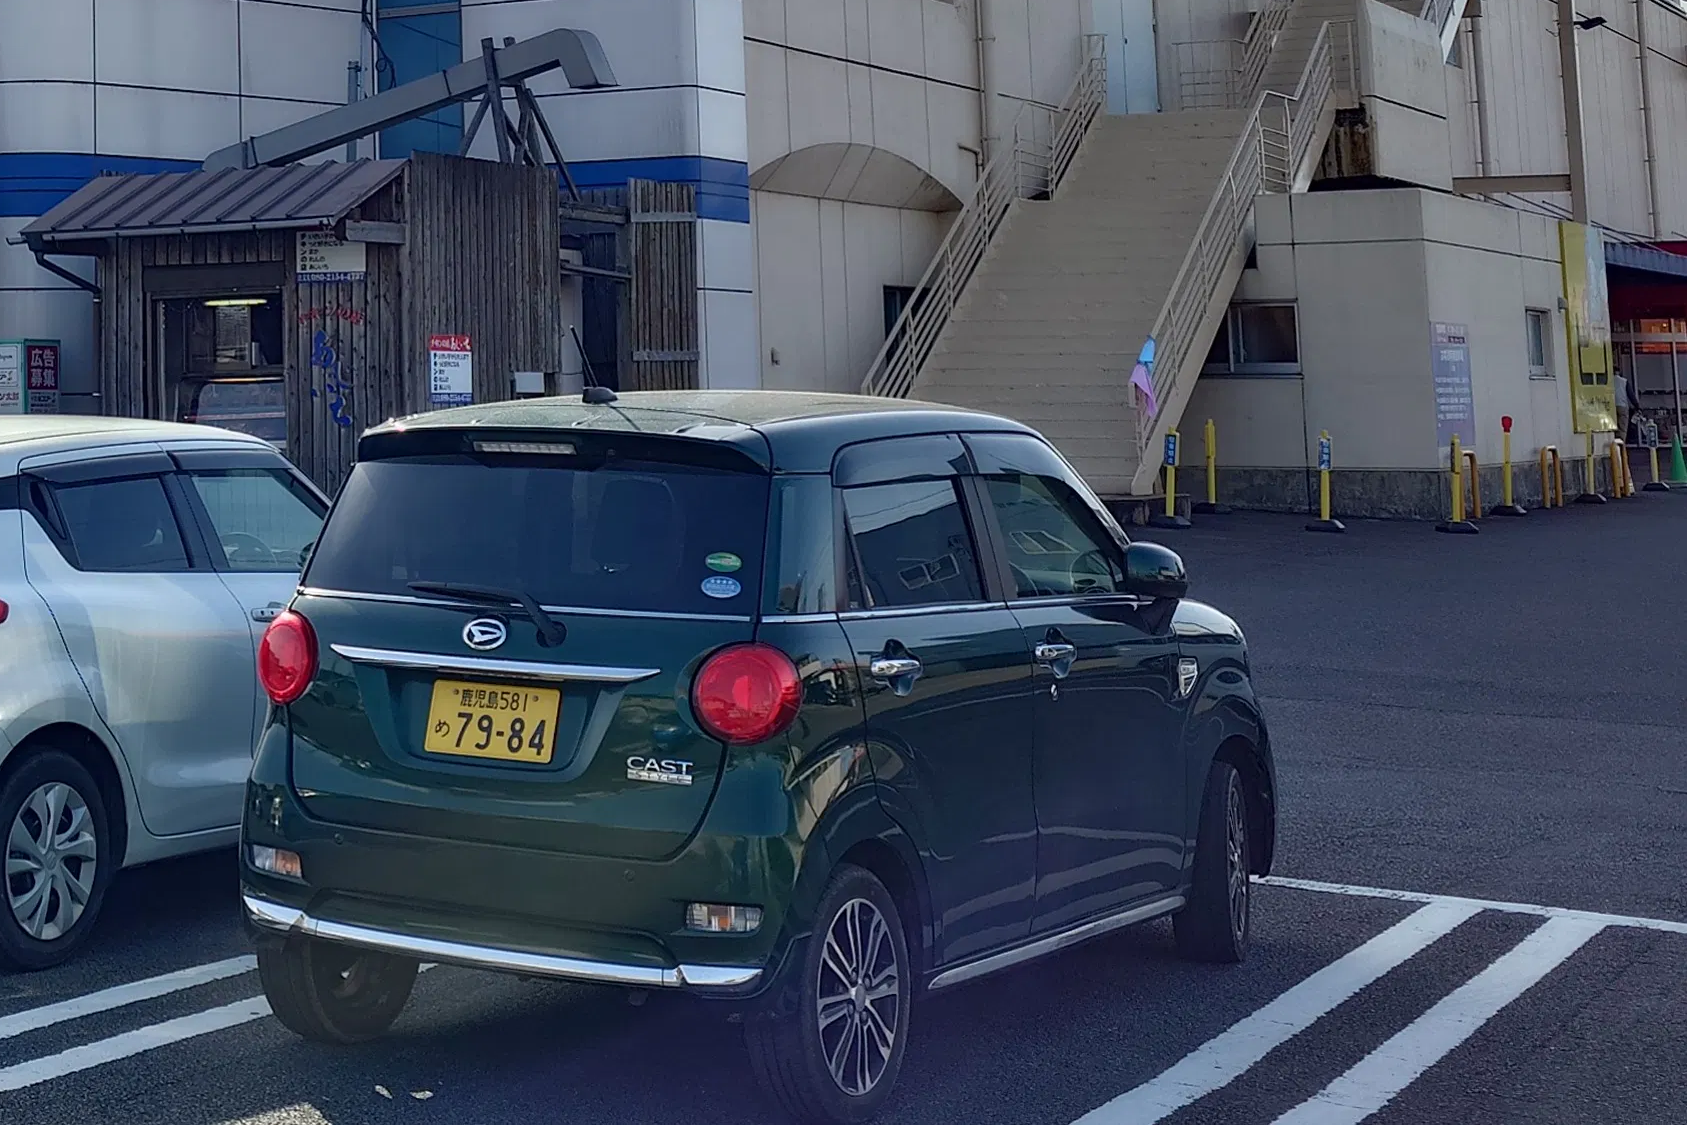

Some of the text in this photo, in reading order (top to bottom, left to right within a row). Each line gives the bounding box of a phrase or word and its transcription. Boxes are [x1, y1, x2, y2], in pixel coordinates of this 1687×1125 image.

[30, 348, 56, 367] 広告
[30, 368, 56, 388] 募集
[460, 689, 528, 712] 鹿児島581
[435, 711, 546, 755] め 79-84
[626, 756, 693, 775] CAST
